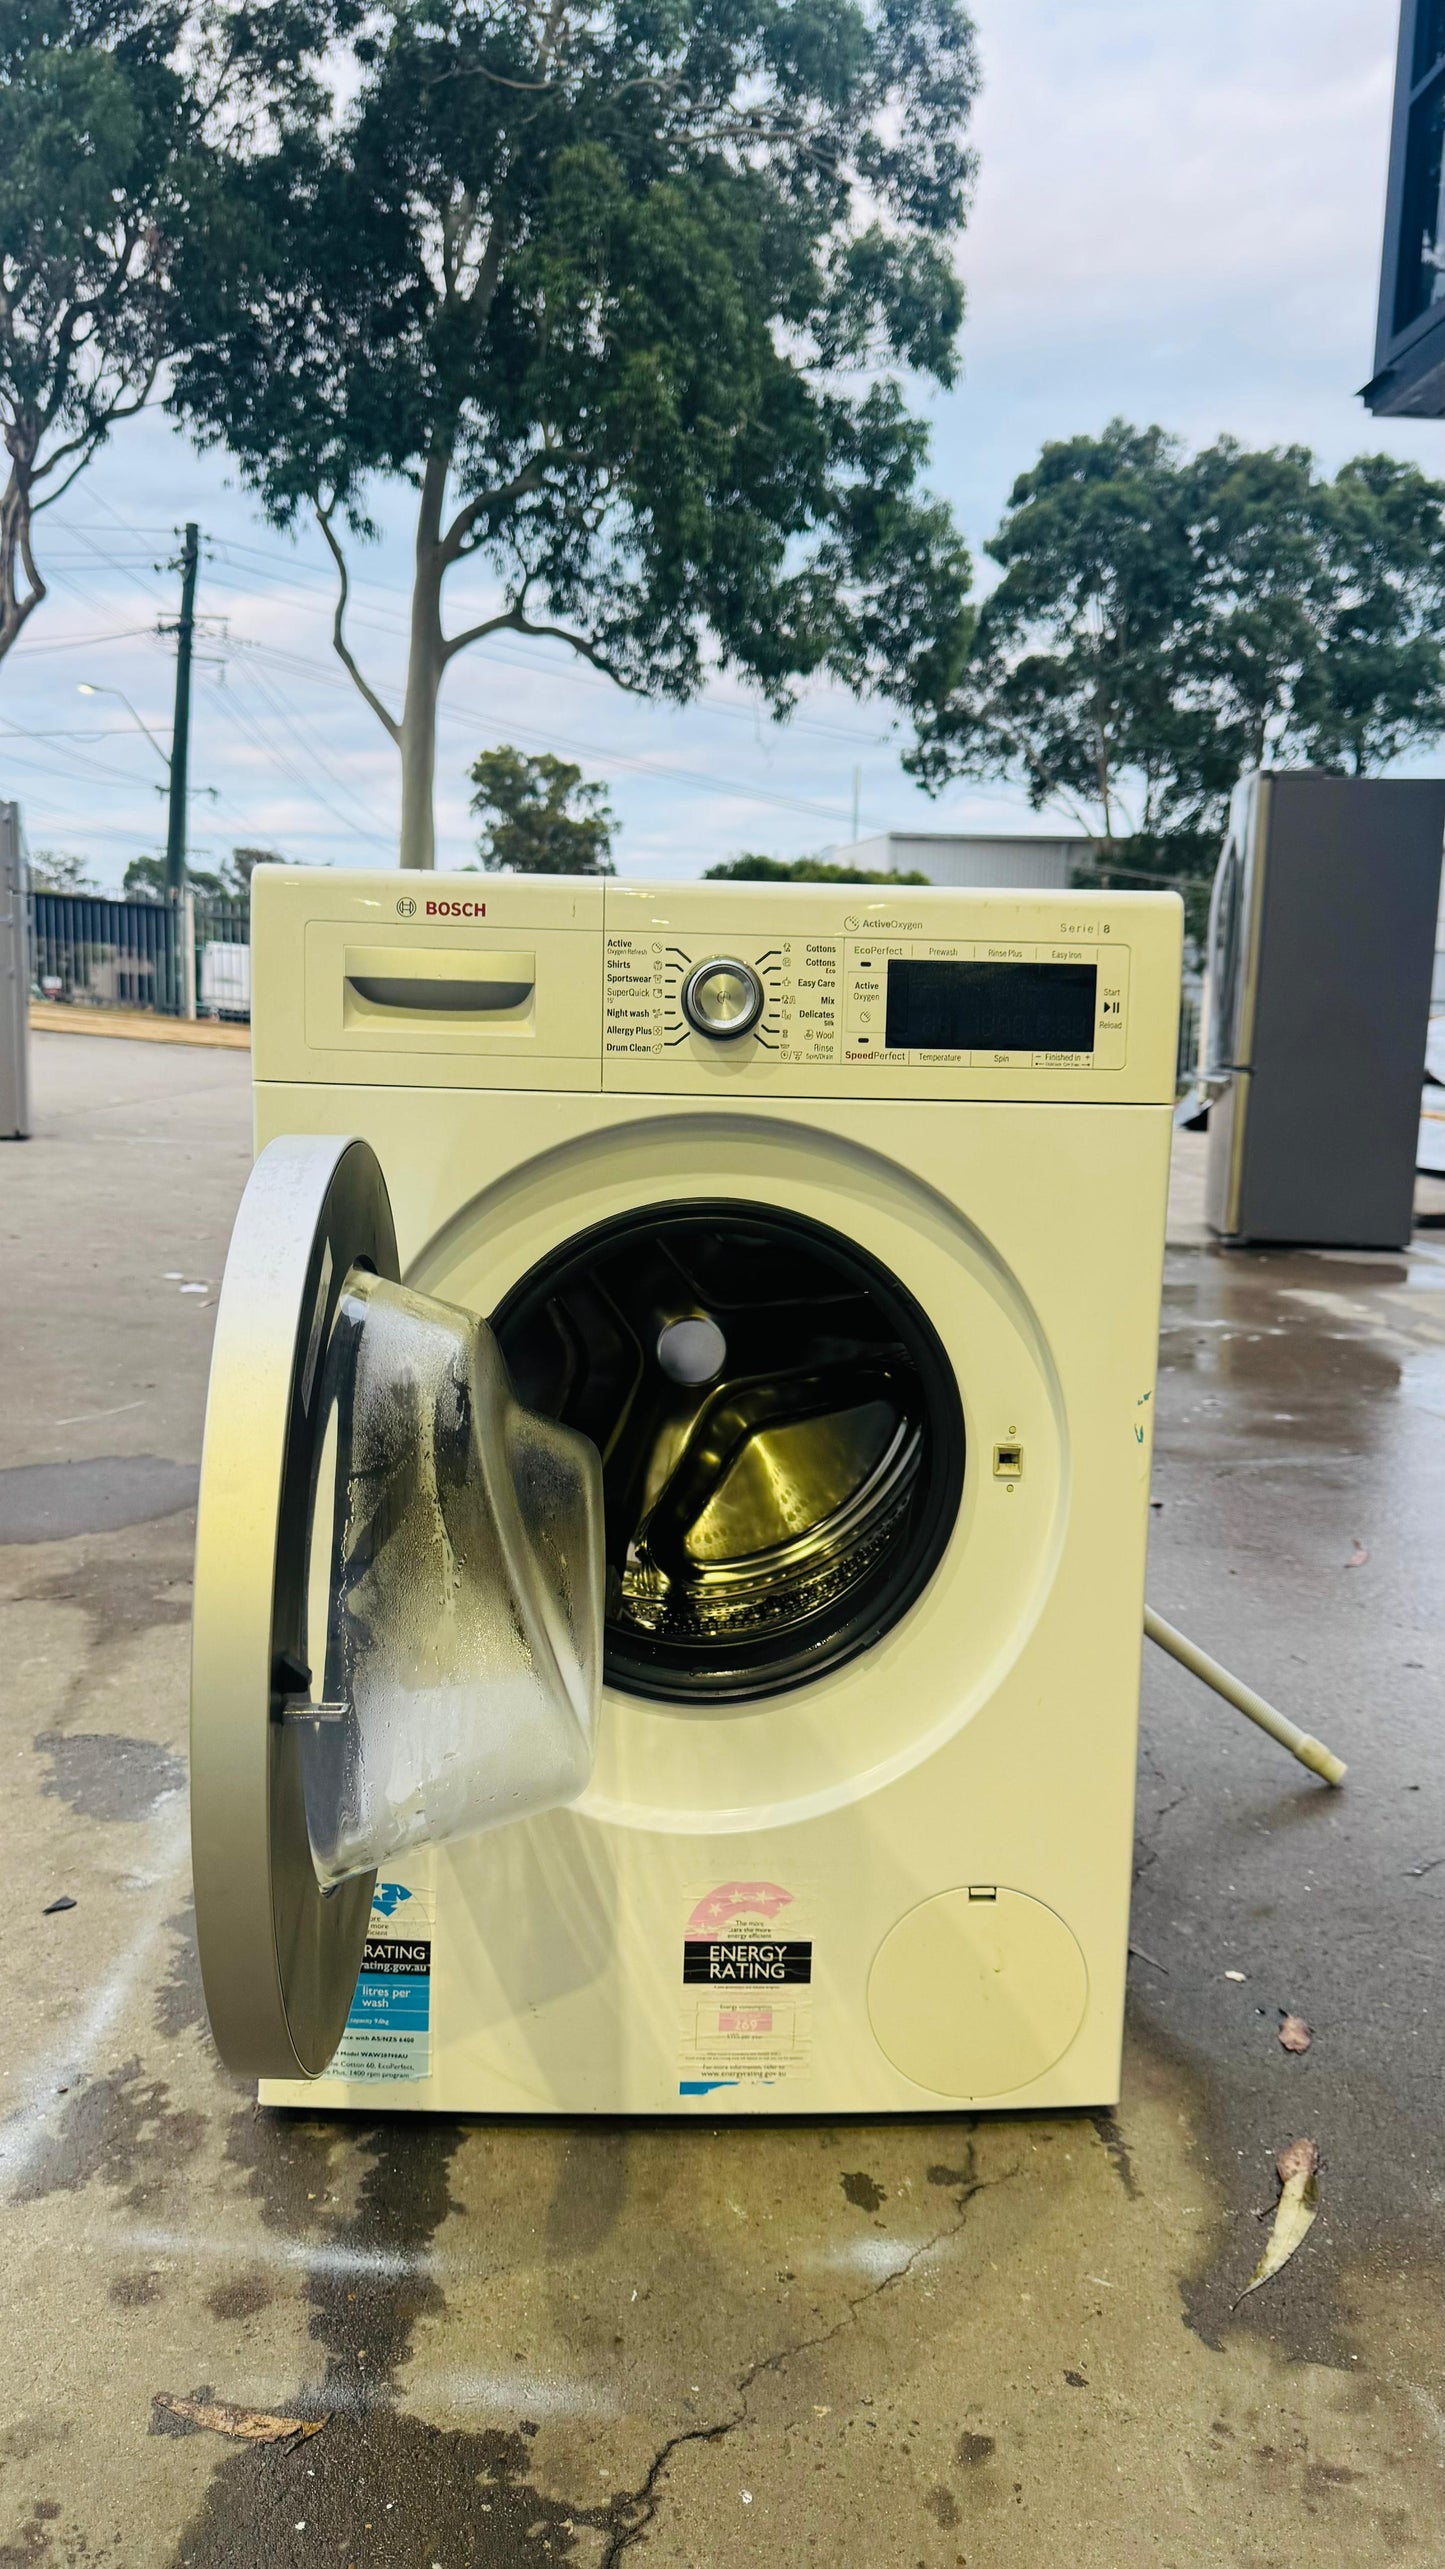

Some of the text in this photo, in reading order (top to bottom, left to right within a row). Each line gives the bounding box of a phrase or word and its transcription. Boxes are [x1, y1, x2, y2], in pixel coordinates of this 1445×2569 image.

[426, 901, 486, 917] BOSCH
[862, 919, 923, 931] ActiveOxygen
[1060, 923, 1111, 934] Serie 8
[607, 938, 632, 948] Active
[806, 944, 836, 953] Cottons
[854, 946, 903, 956] EcoPerfect
[929, 948, 958, 957] Prewash
[988, 949, 1022, 958] Rinse Plus
[1052, 950, 1082, 960] Easy Iron
[607, 960, 631, 969] Shirts
[806, 958, 836, 967] Cottons
[607, 974, 652, 984] Sportswear
[798, 979, 835, 988] Easy Care
[854, 982, 879, 990] Active
[607, 988, 650, 998] SuperQuick
[1104, 988, 1121, 996] Start
[820, 996, 835, 1005] Mix
[853, 993, 880, 1002] Oxygen
[607, 1009, 650, 1018] Night wash
[799, 1010, 835, 1019] Delicates
[1099, 1021, 1122, 1029] Reload
[607, 1026, 652, 1036] Allergy Plus
[816, 1031, 834, 1039] Wool
[606, 1043, 651, 1052] Drum Clean
[814, 1044, 834, 1052] Rinse
[845, 1051, 905, 1061] SpeedPerfect
[919, 1052, 961, 1062] Temperature
[994, 1054, 1009, 1064] Spin
[1045, 1053, 1073, 1061] Finished
[364, 1944, 426, 1960] RATING
[710, 1945, 787, 1962] ENERGY
[361, 1961, 427, 1973] rating.gov.au
[710, 1963, 785, 1979] RATING
[362, 1985, 411, 2000] litres per
[362, 1998, 389, 2008] wash
